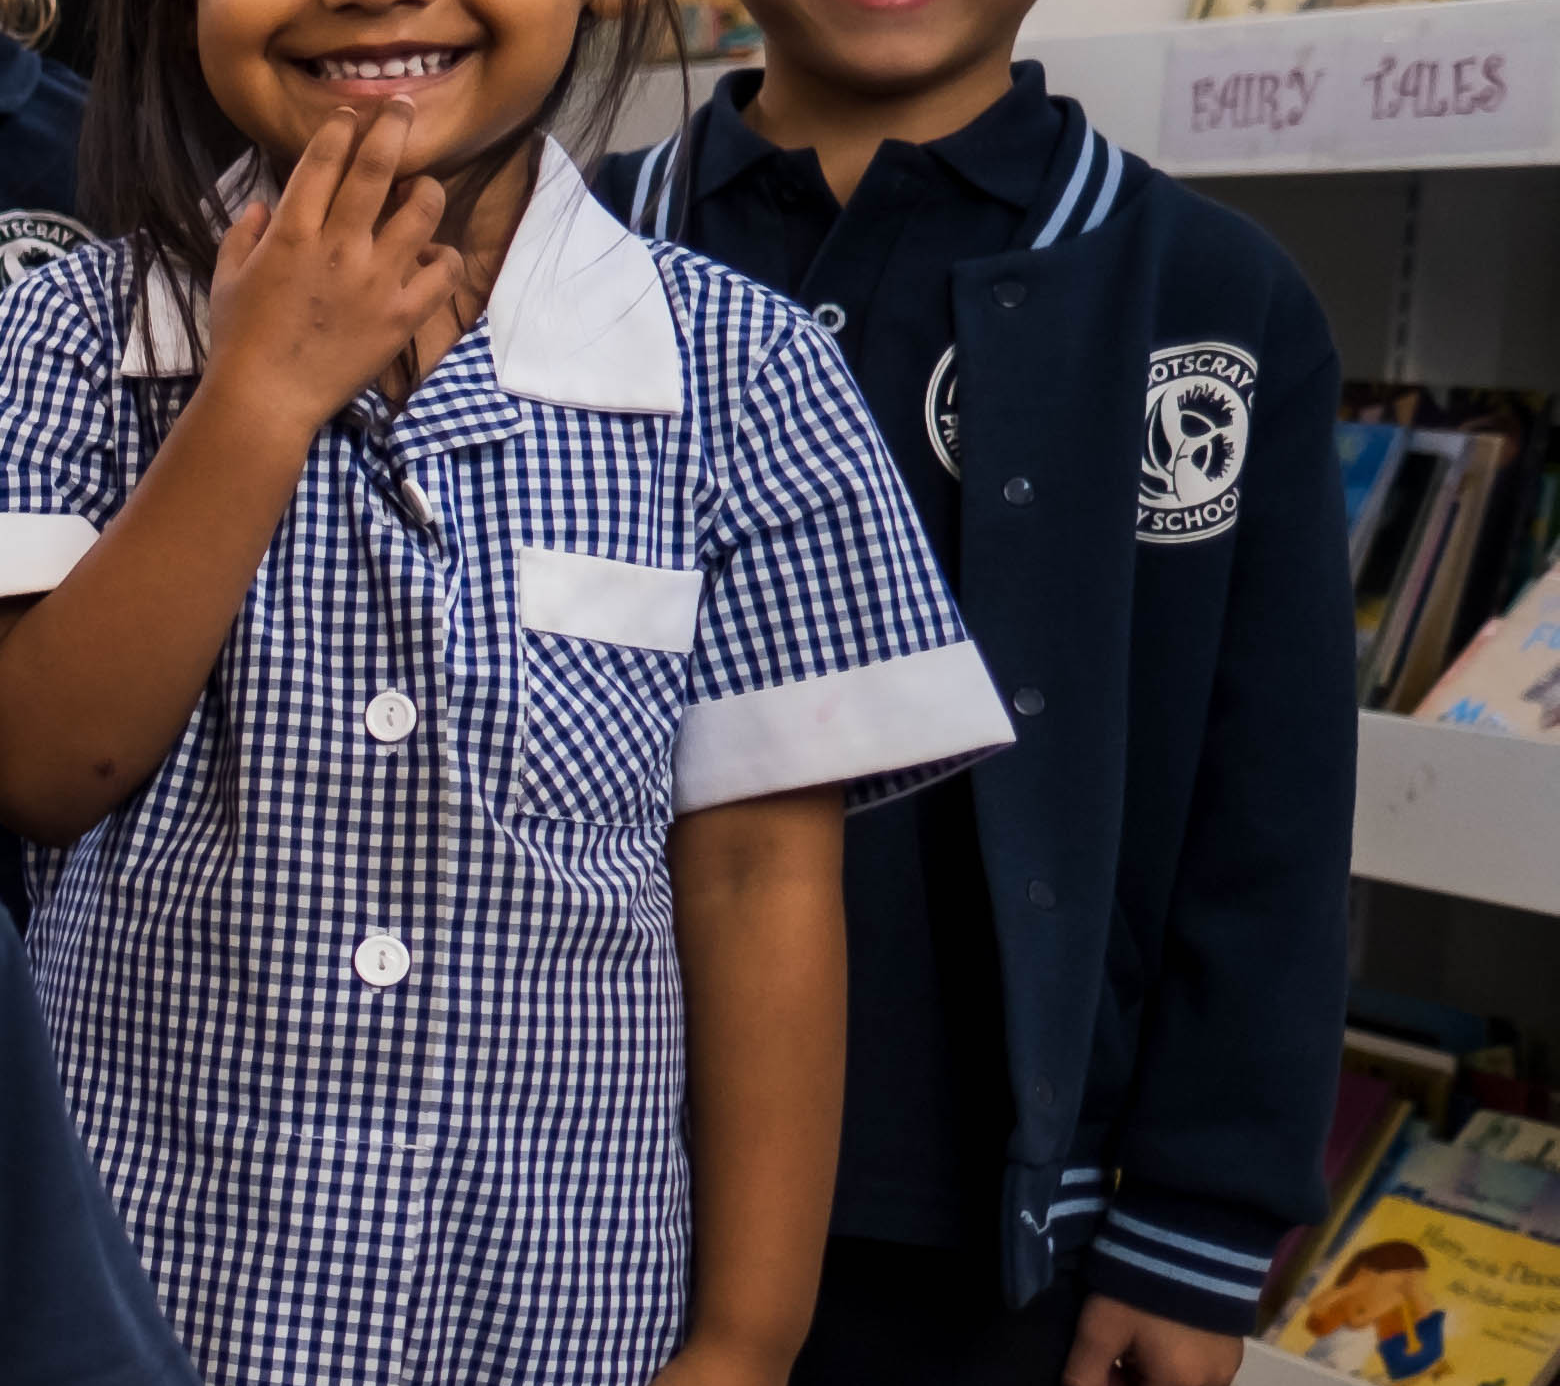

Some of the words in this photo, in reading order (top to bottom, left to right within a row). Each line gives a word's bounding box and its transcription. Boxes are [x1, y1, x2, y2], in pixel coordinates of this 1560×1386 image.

[1190, 65, 1328, 133] FAIRY
[1363, 53, 1509, 122] TALES
[1147, 353, 1256, 391] OTSCRAY
[1151, 486, 1241, 533] SCHOO
